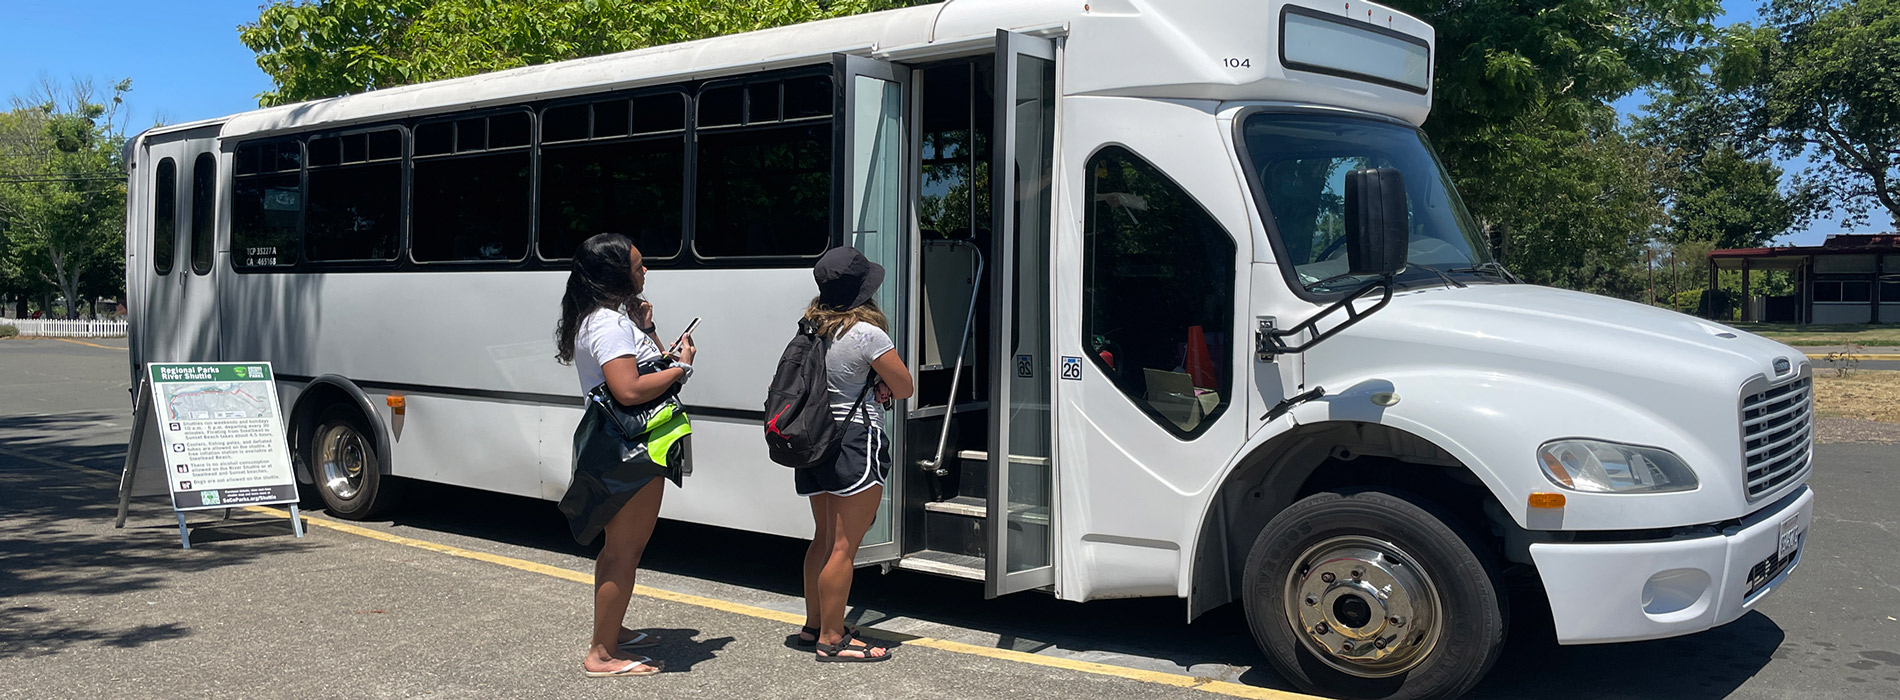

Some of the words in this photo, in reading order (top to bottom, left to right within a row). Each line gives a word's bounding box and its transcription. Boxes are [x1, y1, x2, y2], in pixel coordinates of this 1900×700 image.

[1224, 58, 1250, 68] 104
[272, 246, 276, 254] A
[160, 366, 195, 374] Regional
[1064, 362, 1080, 378] 26
[223, 495, 277, 503] SoCoParks.org/Shuttle
